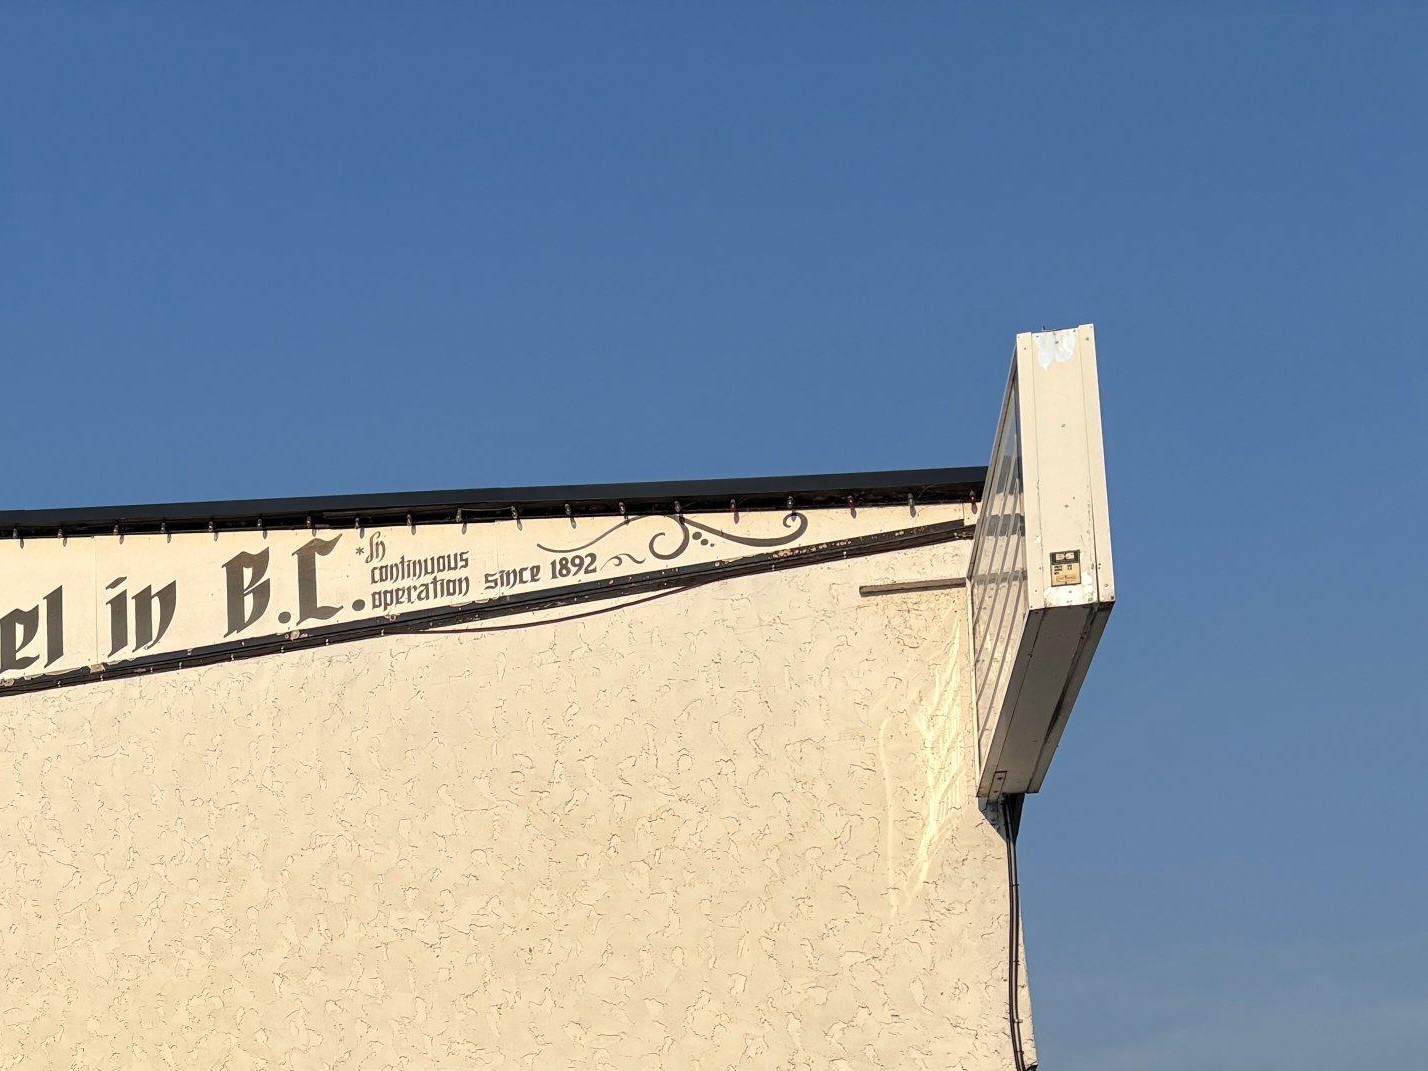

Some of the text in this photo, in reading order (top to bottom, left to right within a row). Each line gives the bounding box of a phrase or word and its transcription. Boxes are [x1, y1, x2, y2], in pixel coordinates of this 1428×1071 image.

[105, 576, 177, 658] in
[221, 533, 366, 638] B.C.
[370, 550, 470, 585] continuous
[371, 552, 598, 611] operation since 1892
